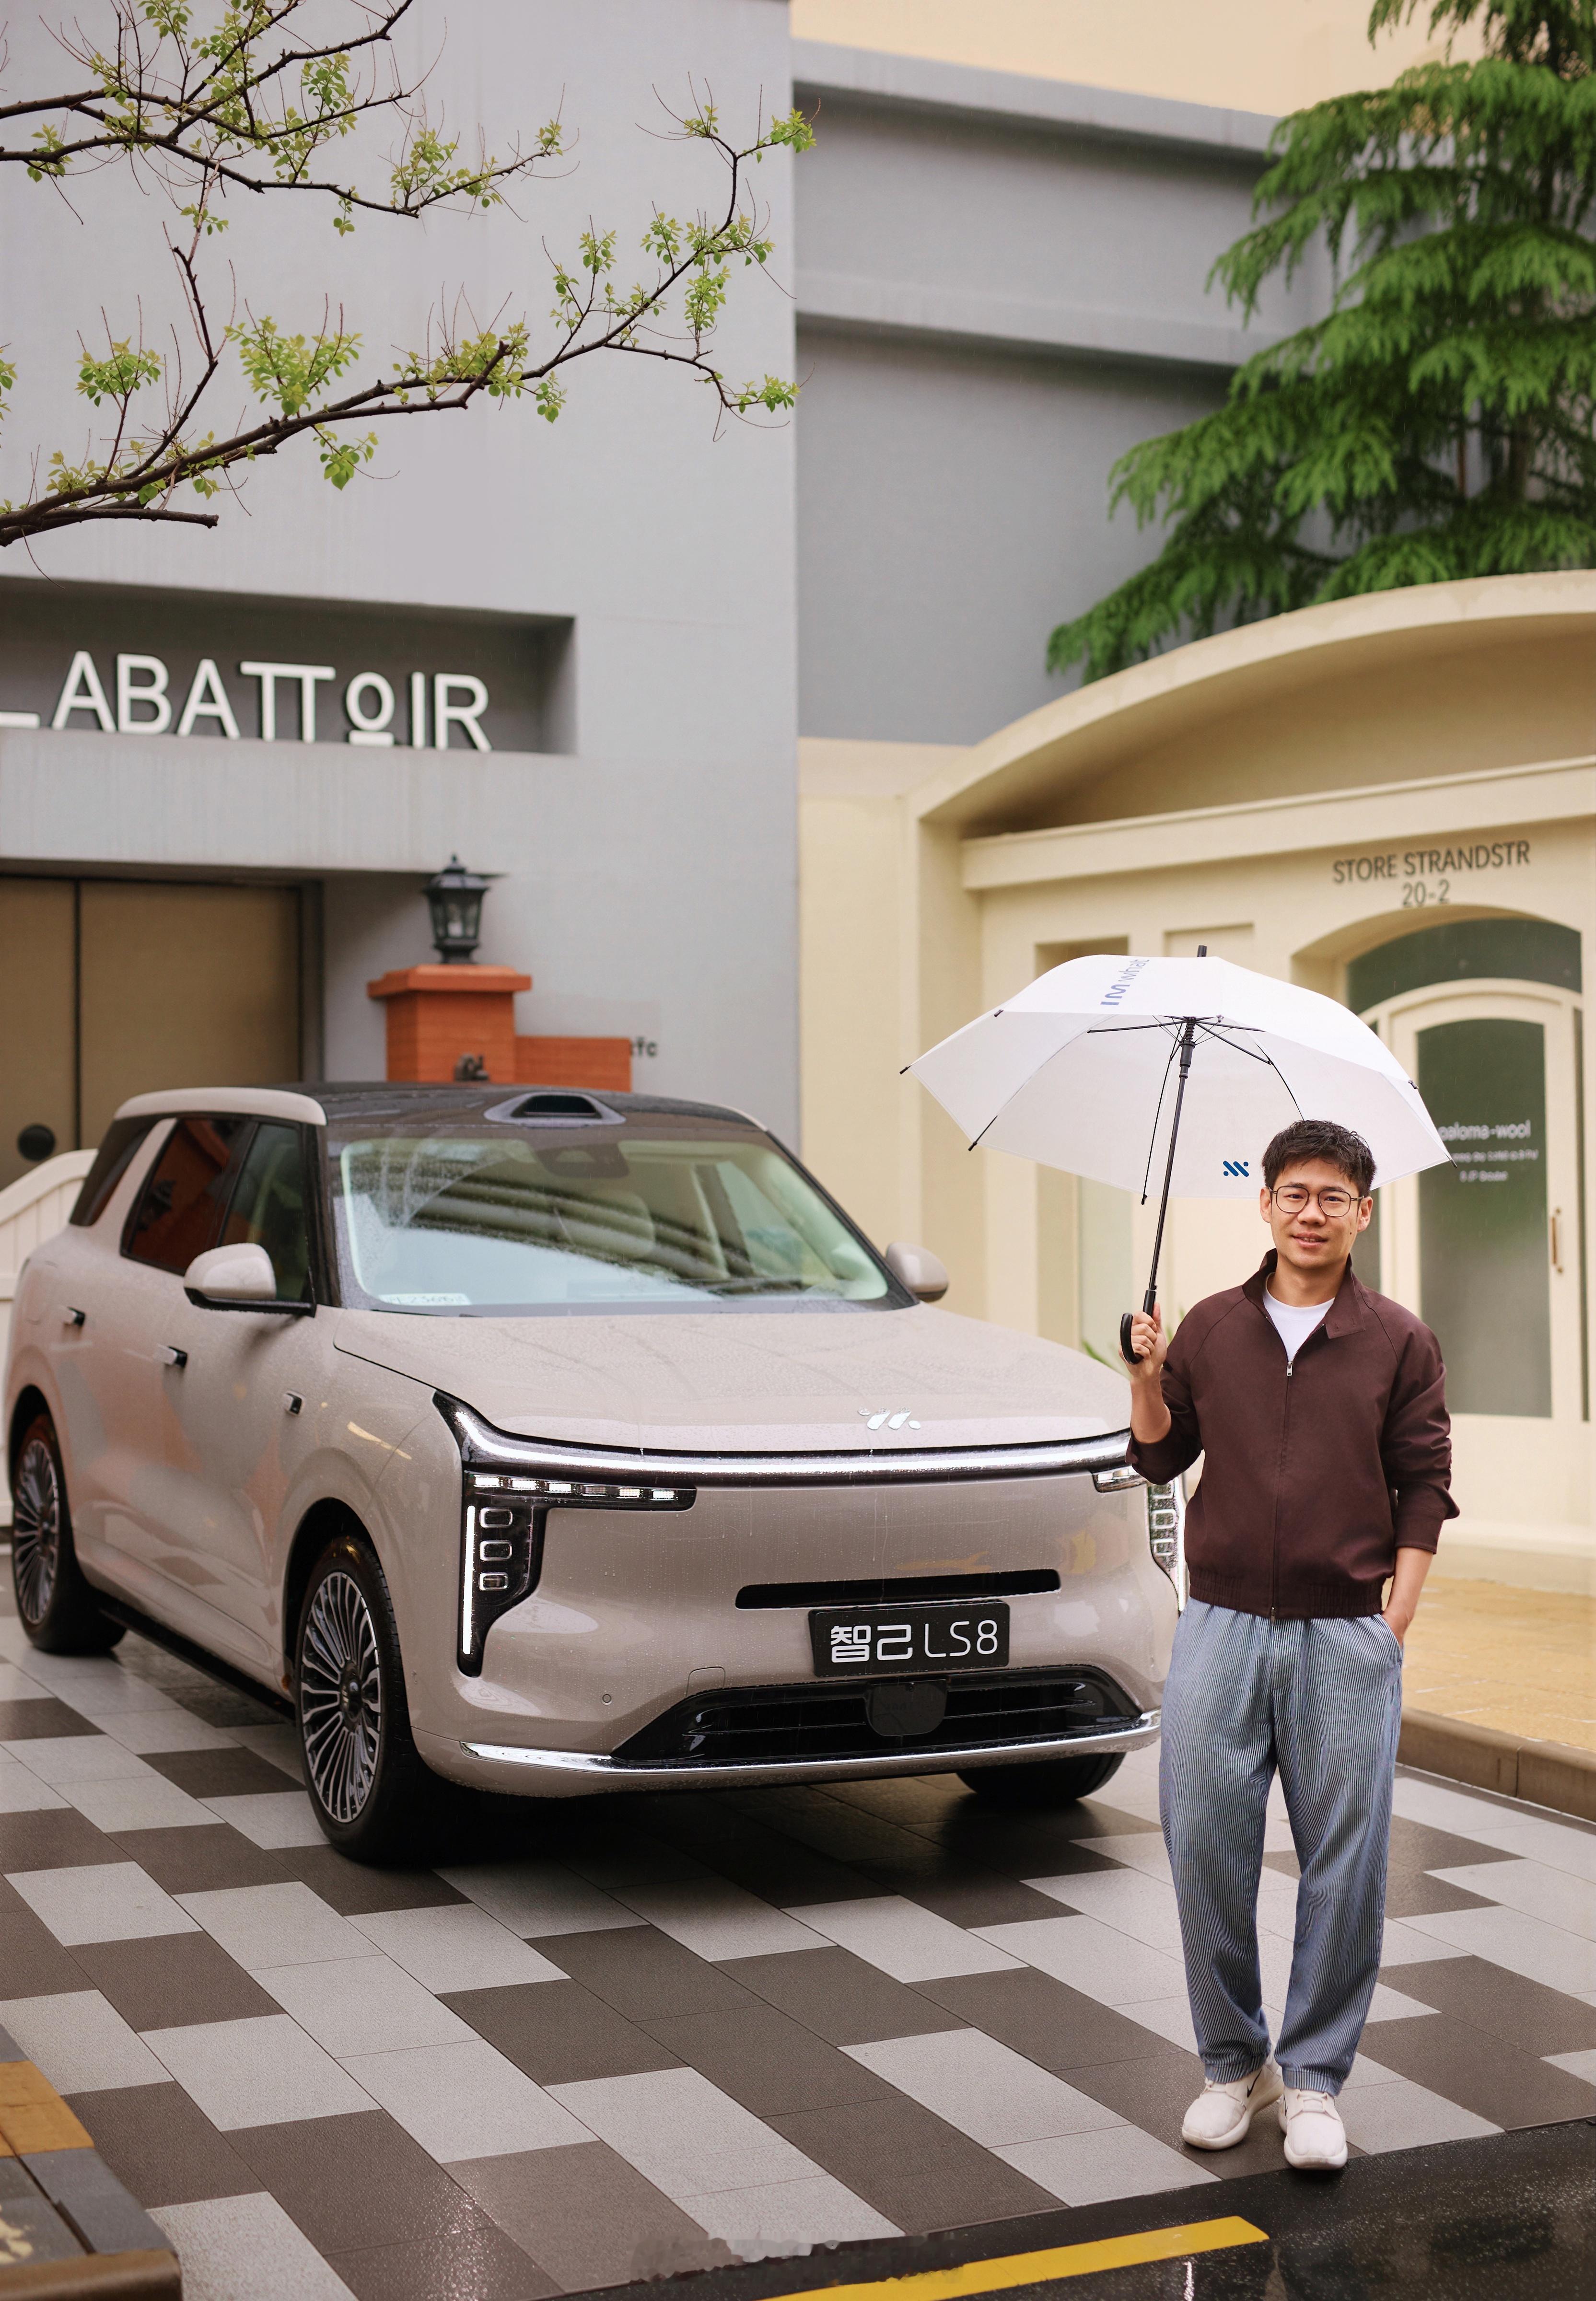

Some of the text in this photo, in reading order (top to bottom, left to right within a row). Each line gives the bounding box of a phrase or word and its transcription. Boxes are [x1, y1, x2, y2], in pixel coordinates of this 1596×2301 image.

[0, 650, 492, 753] ABATTOIR
[1332, 840, 1530, 884] STORE STRANDSTR
[1402, 879, 1450, 908] 20-2
[830, 1619, 998, 1663] 智己 LS8
